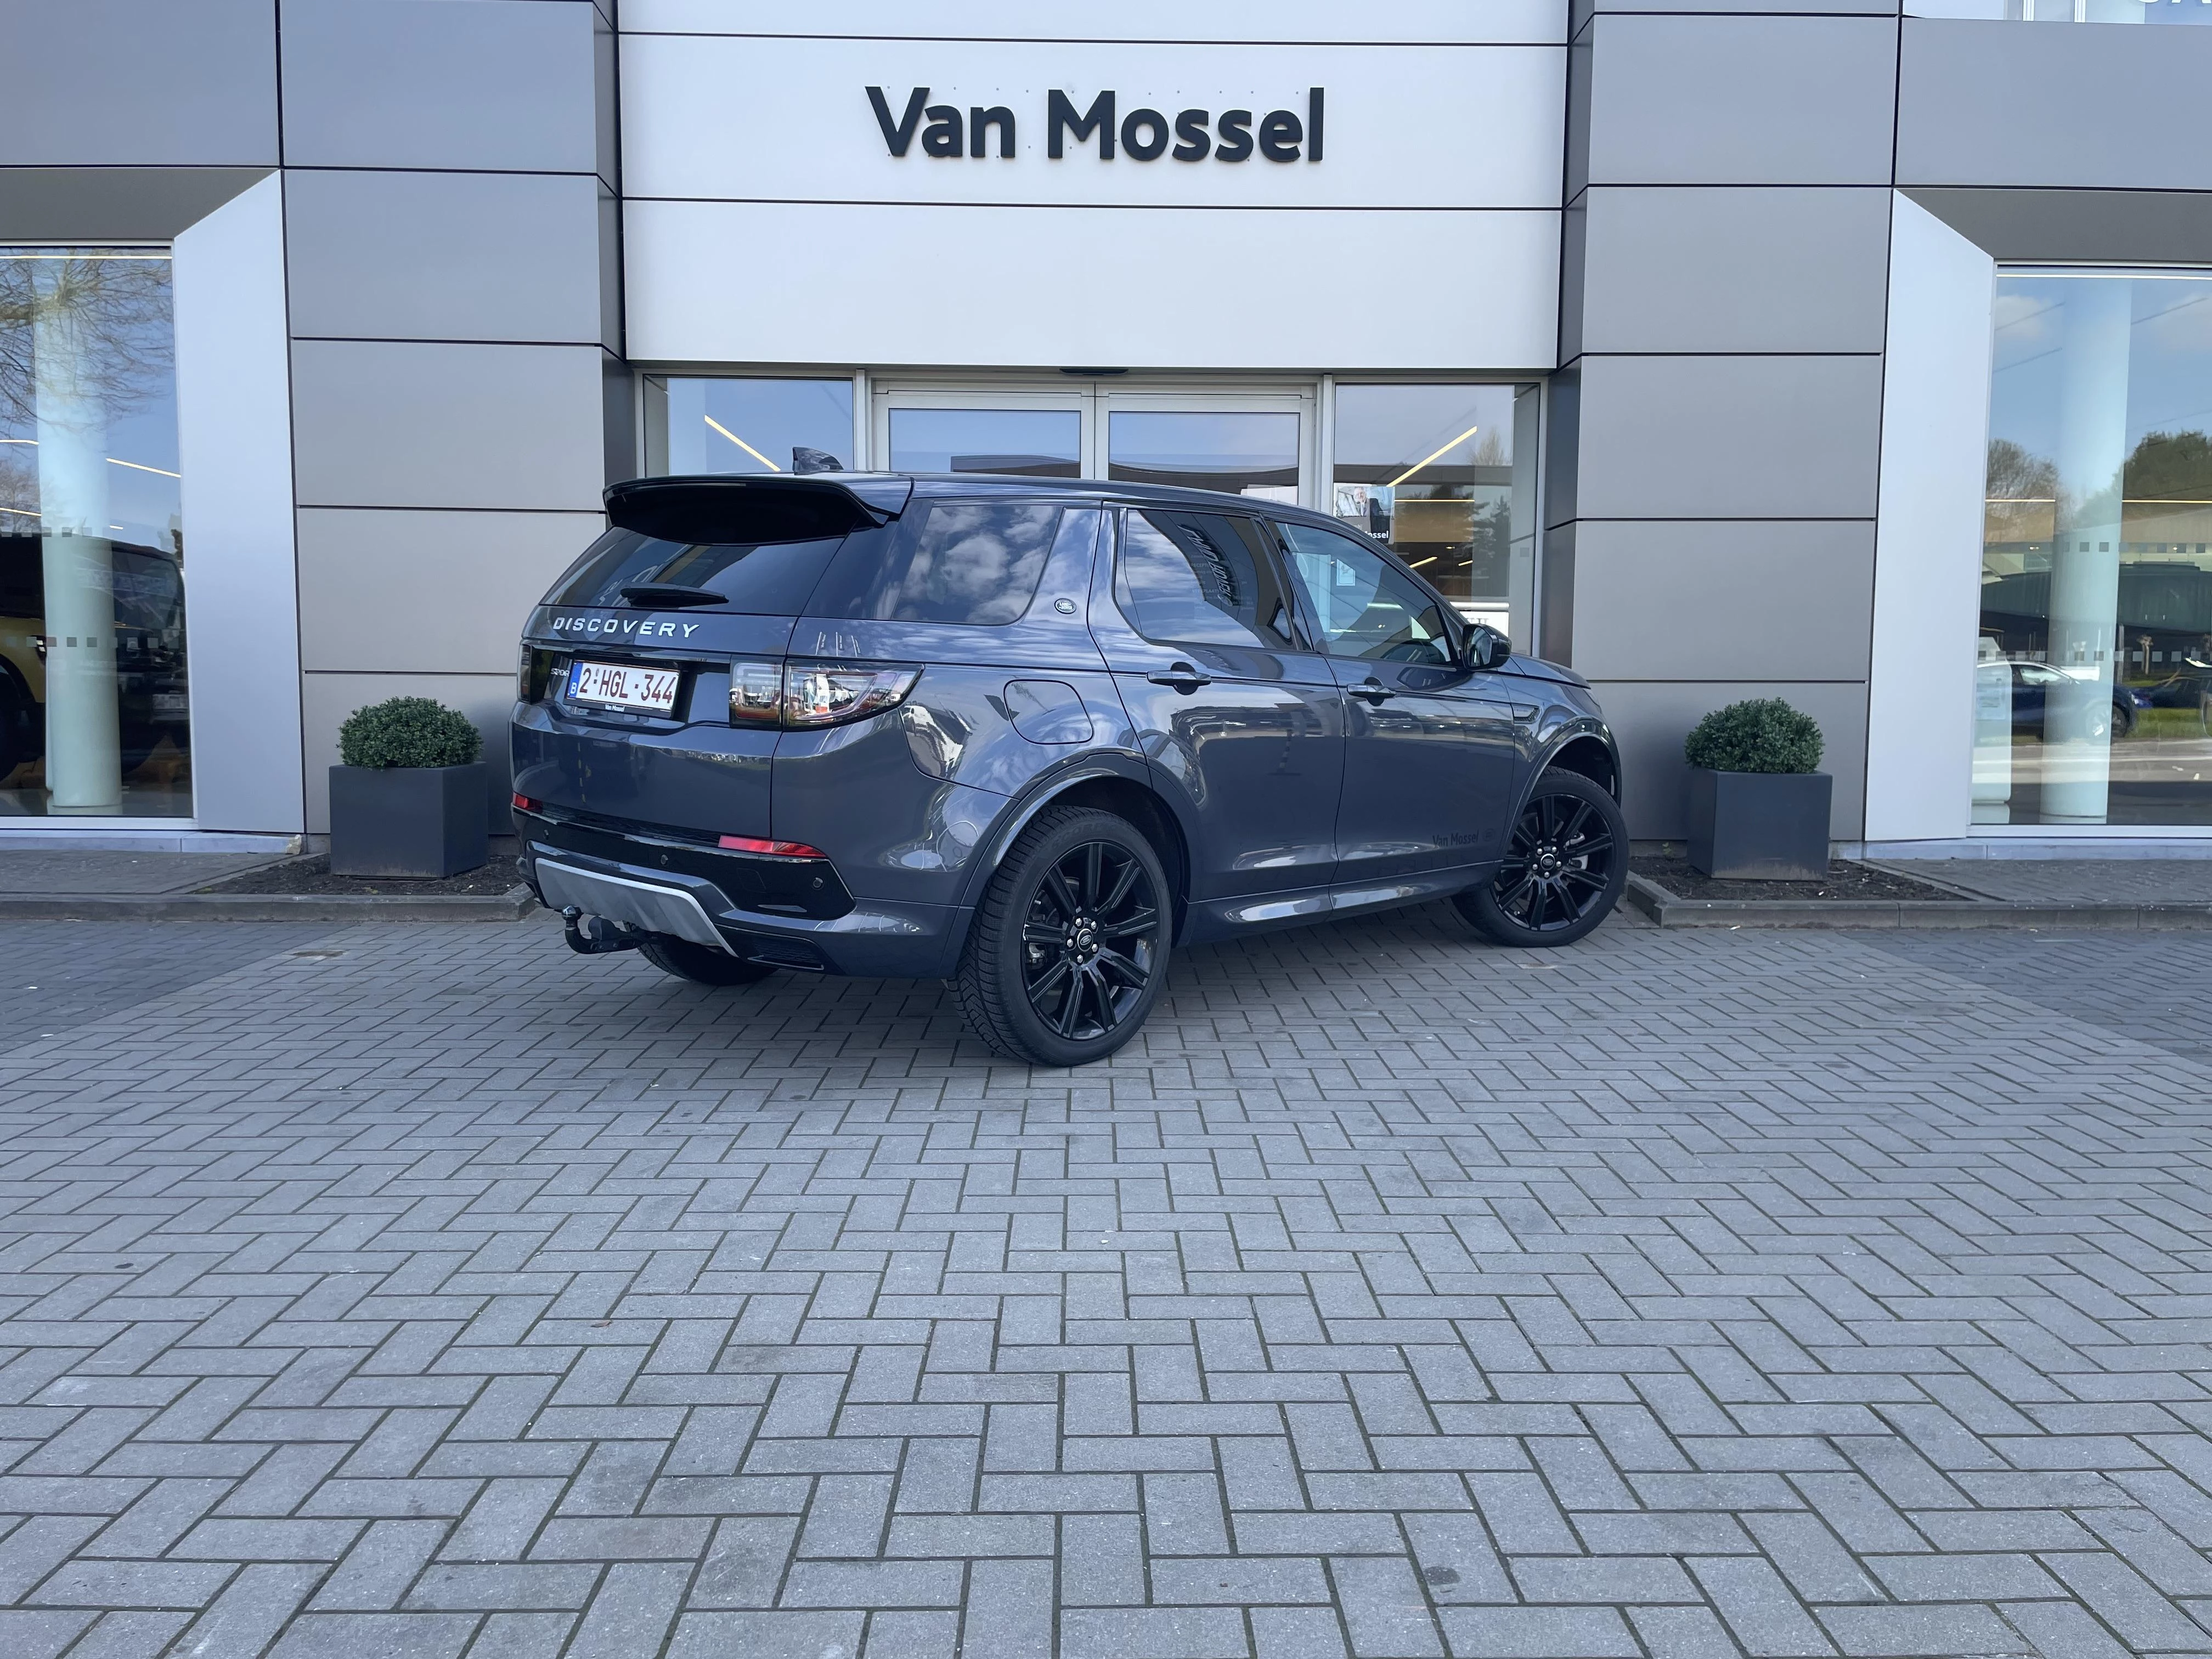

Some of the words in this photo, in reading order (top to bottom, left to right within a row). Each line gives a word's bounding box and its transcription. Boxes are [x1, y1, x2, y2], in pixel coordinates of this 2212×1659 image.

[865, 86, 1016, 158] Van
[1048, 87, 1324, 162] Mossel
[1365, 531, 1389, 539] ossel
[553, 617, 700, 638] DISCOVERY
[570, 682, 578, 695] B
[1432, 834, 1448, 848] Van
[1451, 829, 1479, 846] Mossel
